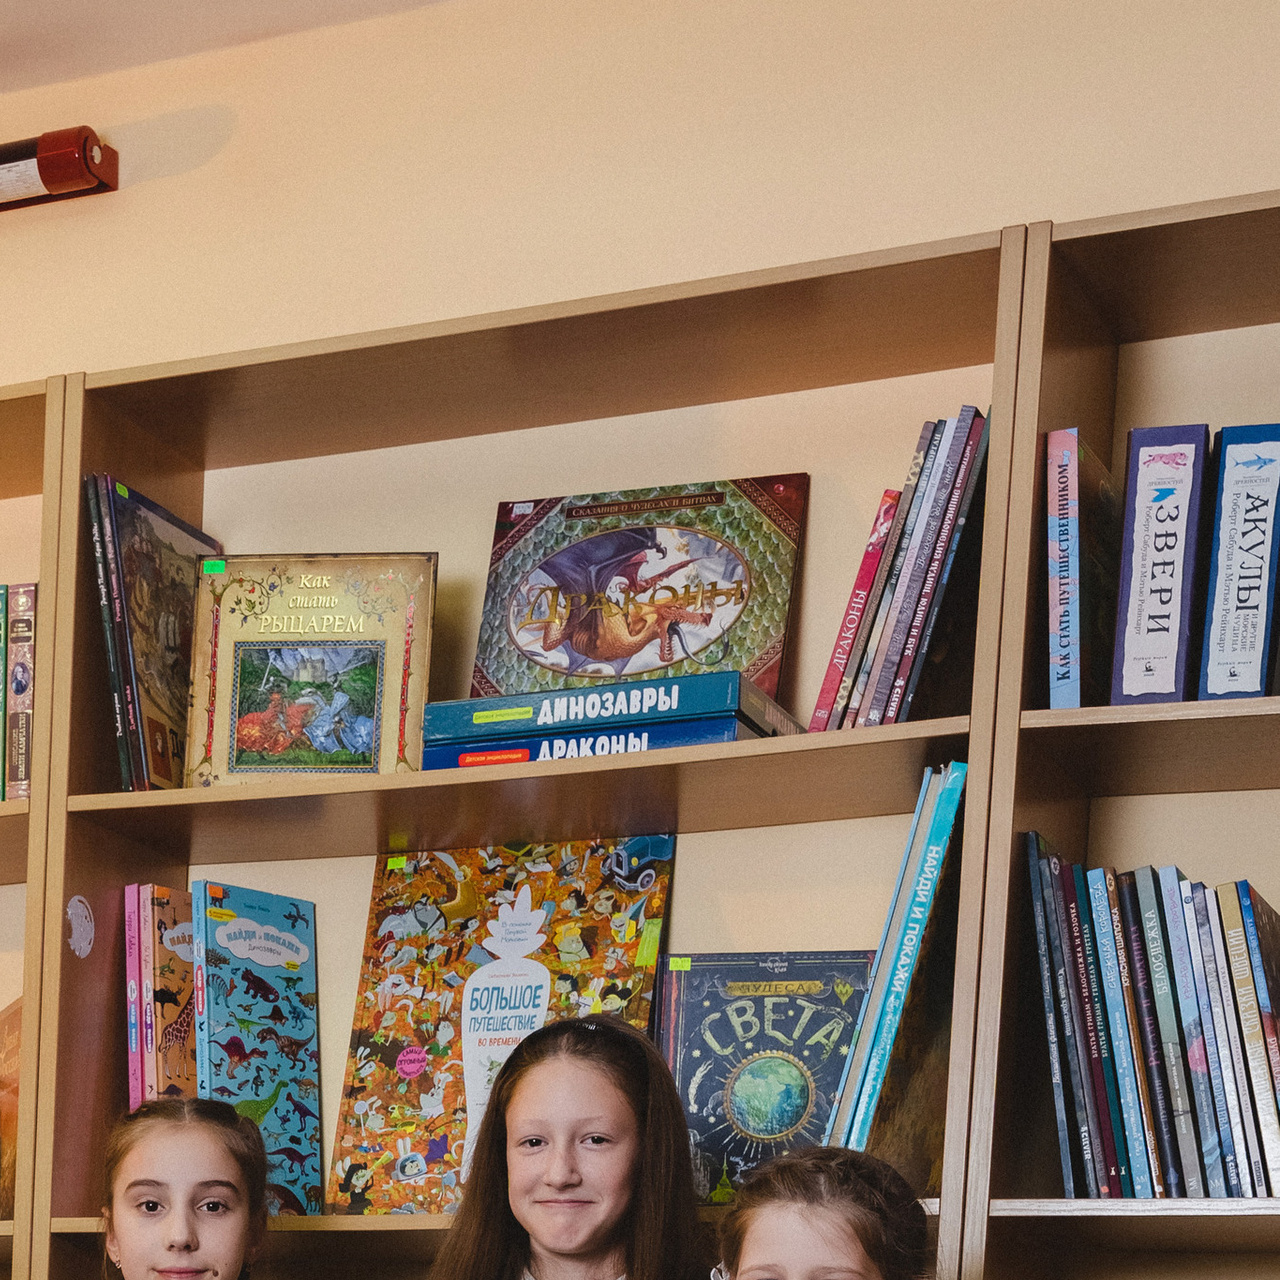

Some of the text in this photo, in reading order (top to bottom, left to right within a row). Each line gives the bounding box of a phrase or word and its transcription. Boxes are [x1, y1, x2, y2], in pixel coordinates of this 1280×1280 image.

[572, 505, 620, 517] СКАЗАНИЯ
[629, 501, 670, 512] ЧУДЕСАХ
[683, 495, 717, 506] БИТВАХ
[1143, 505, 1153, 533] Роберт
[1228, 492, 1241, 526] Роберт
[1236, 492, 1269, 612] АКУЛЫ
[299, 574, 331, 589] Как
[1057, 464, 1071, 682] КАК СТАТЬ ПУТЕШЕСТВЕННИКОМ
[1146, 504, 1180, 635] ЗВЕРИ
[289, 595, 338, 609] стать
[1221, 572, 1233, 606] Мэтью
[517, 580, 744, 636] ДРАКОНЫ
[258, 615, 365, 636] РЫЦАРЕМ
[833, 589, 868, 672] ДРАКОНЫ
[1216, 608, 1230, 653] Рейнхарт
[536, 685, 679, 726] ДИНОЗАВРЫ
[884, 686, 901, 717] CLEVER
[536, 733, 650, 762] ДРАКОНЫ
[891, 845, 941, 993] НАЙДИ И ПОКАЖИ
[1070, 902, 1082, 936] РОЗОЧКА
[1082, 924, 1094, 954] ГРЕТЕЛЬ
[1111, 907, 1130, 988] КРАСНАЯ ШАПОЧКА
[1145, 909, 1170, 996] БЕЛОСНЕЖКА
[1227, 928, 1250, 980] ШВЕЦИИ
[1075, 946, 1090, 998] БЕЛОСНЕЖКА
[1089, 963, 1100, 996] ГЕНЗЕЛЬ
[1101, 938, 1118, 990] СНЕЖНАЯ
[1177, 947, 1194, 1000] КРАСАВИЦА
[470, 984, 544, 1014] БОЛЬШОЕ
[740, 982, 807, 995] ЧУДЕСА
[469, 1015, 537, 1033] ПУТЕШЕСТВИЕ
[1085, 1003, 1096, 1032] ГРИММ
[1094, 1002, 1106, 1030] ГРИММ
[1237, 985, 1260, 1034] СКАЗКИ
[478, 1037, 522, 1047] ВО ВРЕМЕНИ
[701, 997, 846, 1061] СВЕТА
[1087, 1031, 1098, 1058] БРАТЬЯ
[1097, 1031, 1110, 1058] БРАТЬЯ
[1205, 1024, 1222, 1076] СНЕЖНАЯ
[1081, 1132, 1092, 1160] CLEVER
[1228, 1160, 1238, 1186] CLEVER
